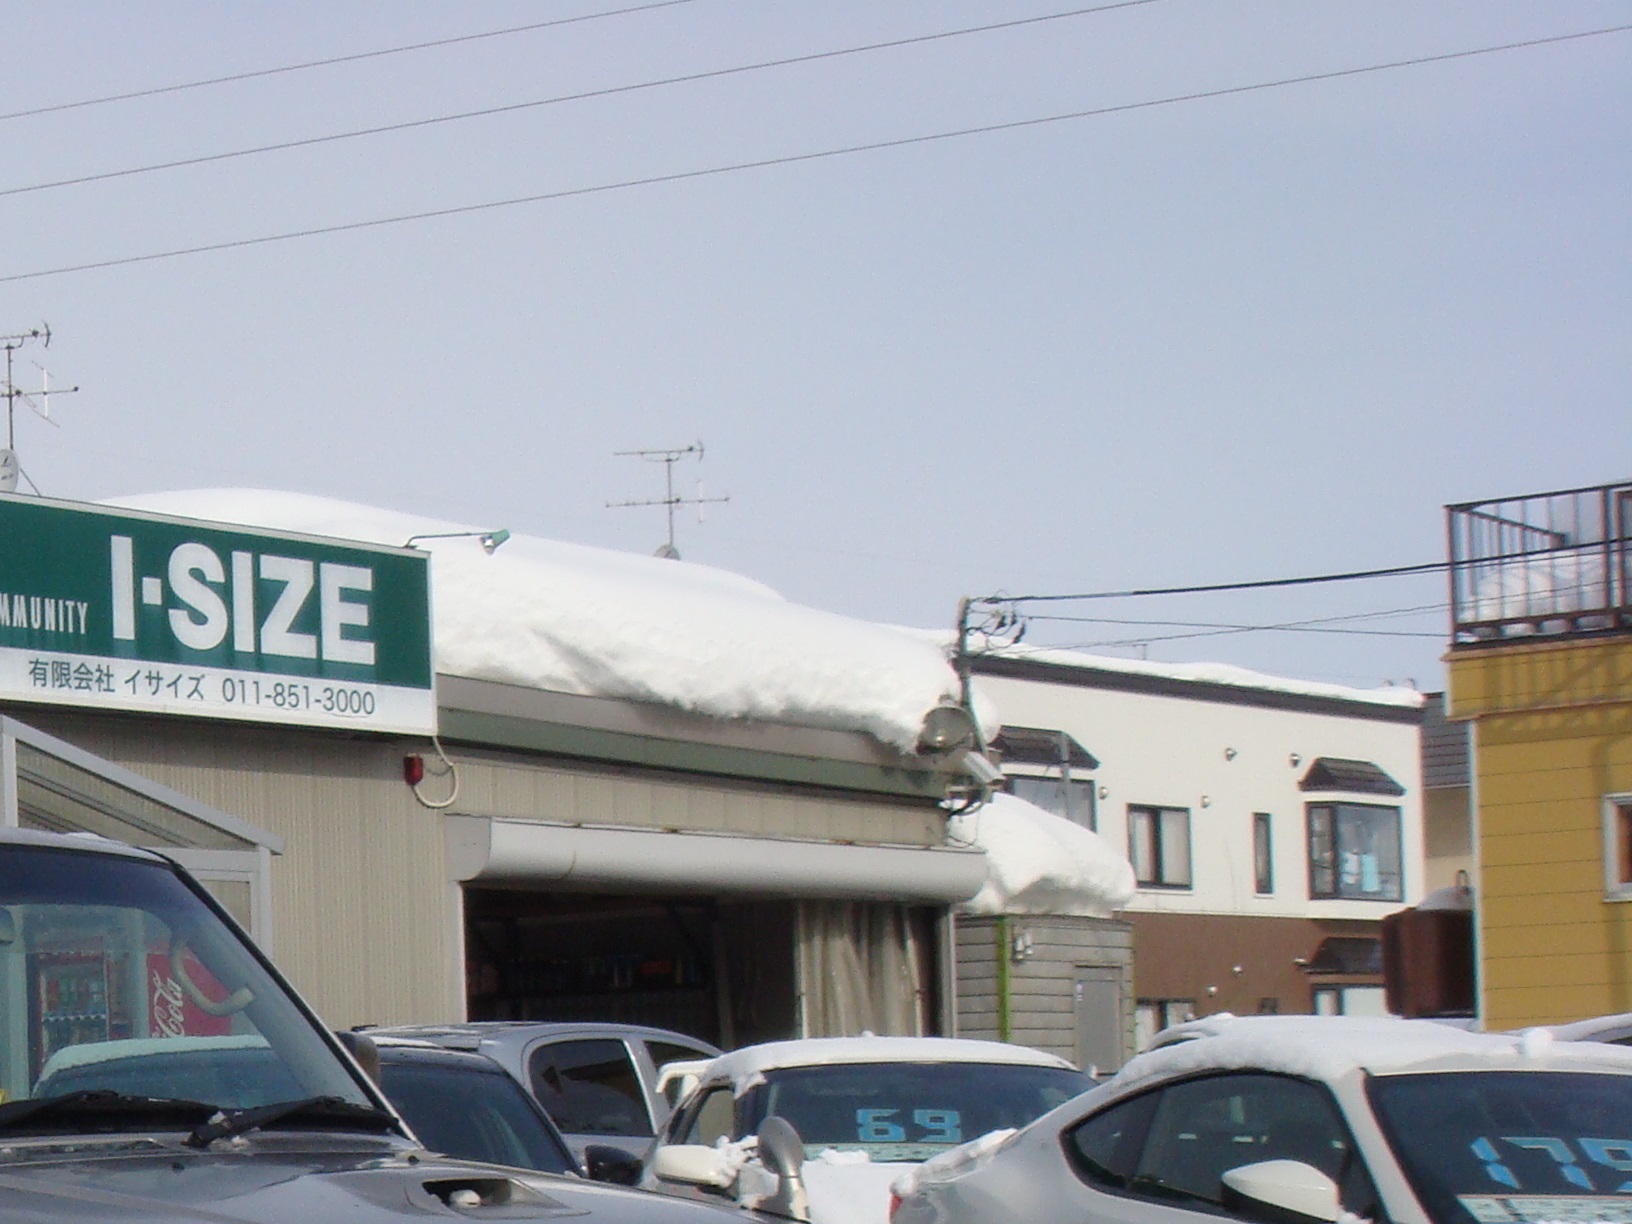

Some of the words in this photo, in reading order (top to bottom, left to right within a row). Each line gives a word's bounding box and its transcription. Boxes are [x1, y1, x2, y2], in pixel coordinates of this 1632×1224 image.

[29, 658, 115, 693] 有限会社
[125, 668, 206, 701] イサイズ
[222, 677, 375, 715] 011-851-3000
[856, 1108, 961, 1143] 69
